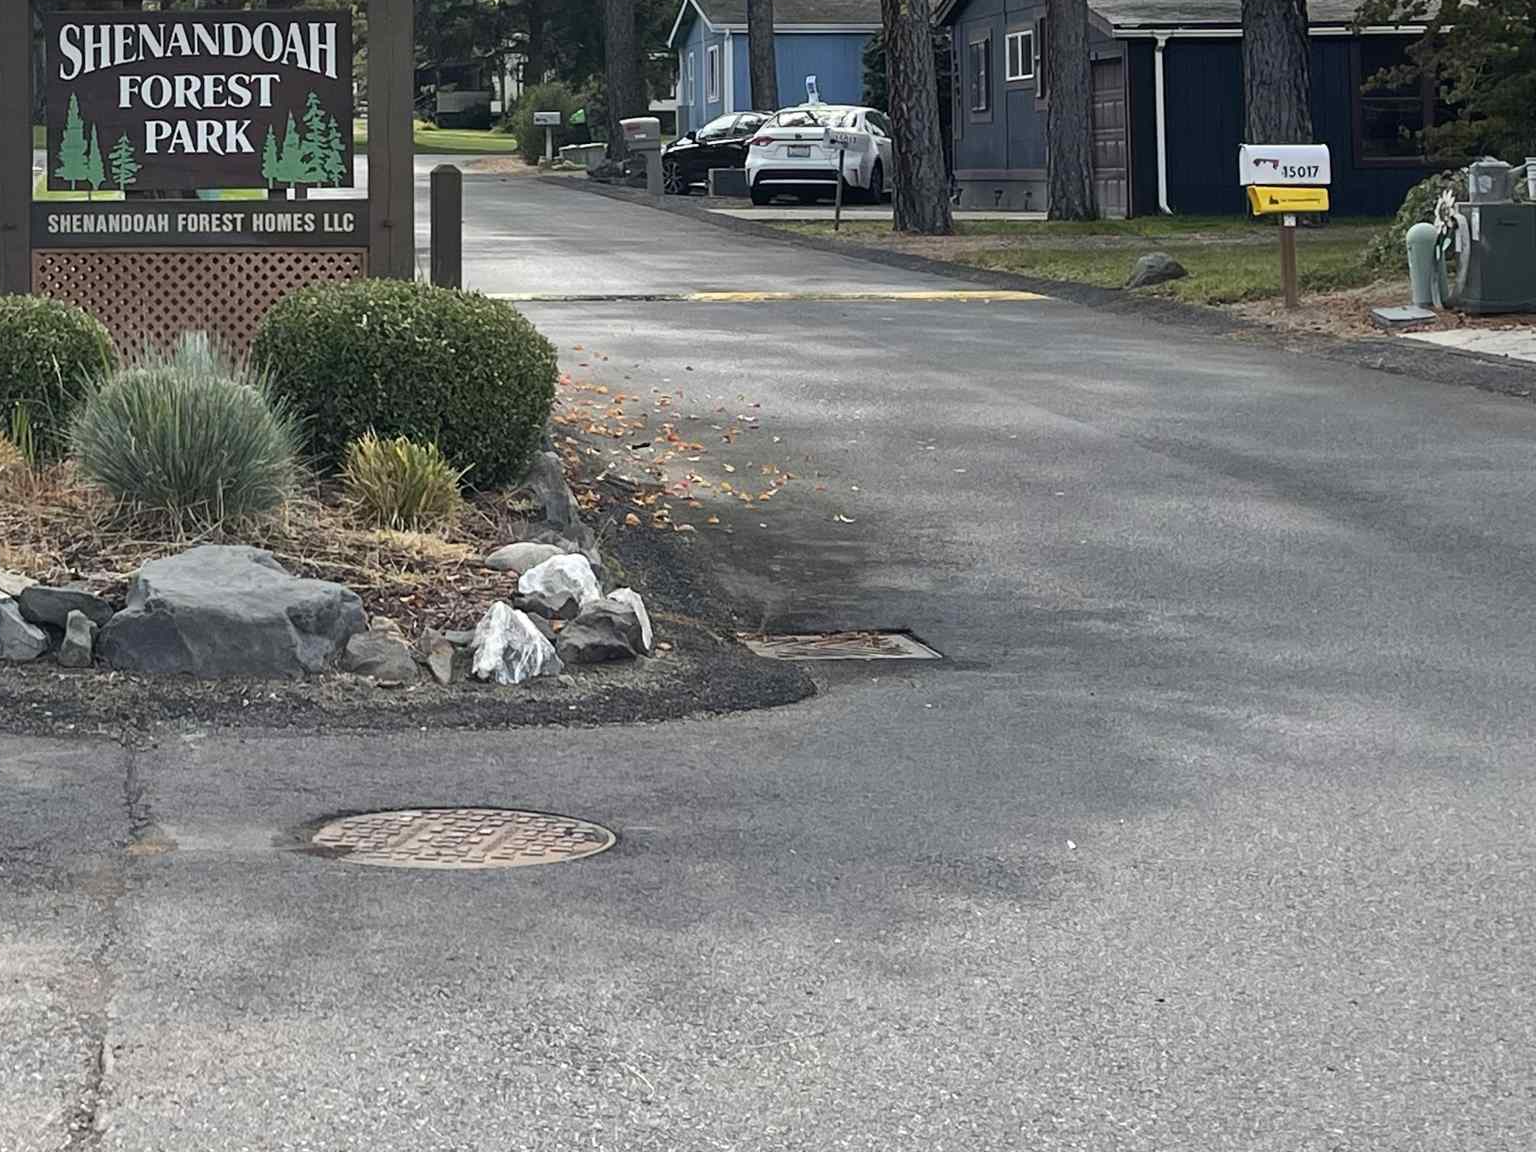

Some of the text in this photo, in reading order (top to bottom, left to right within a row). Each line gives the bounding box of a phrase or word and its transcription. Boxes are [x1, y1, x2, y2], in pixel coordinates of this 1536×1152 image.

[59, 22, 338, 80] SHENANDOAH
[118, 74, 281, 110] FOREST
[144, 119, 256, 156] PARK
[1281, 165, 1320, 178] 15017
[47, 212, 355, 234] SHENANDOAH FOREST HOMES LLC
